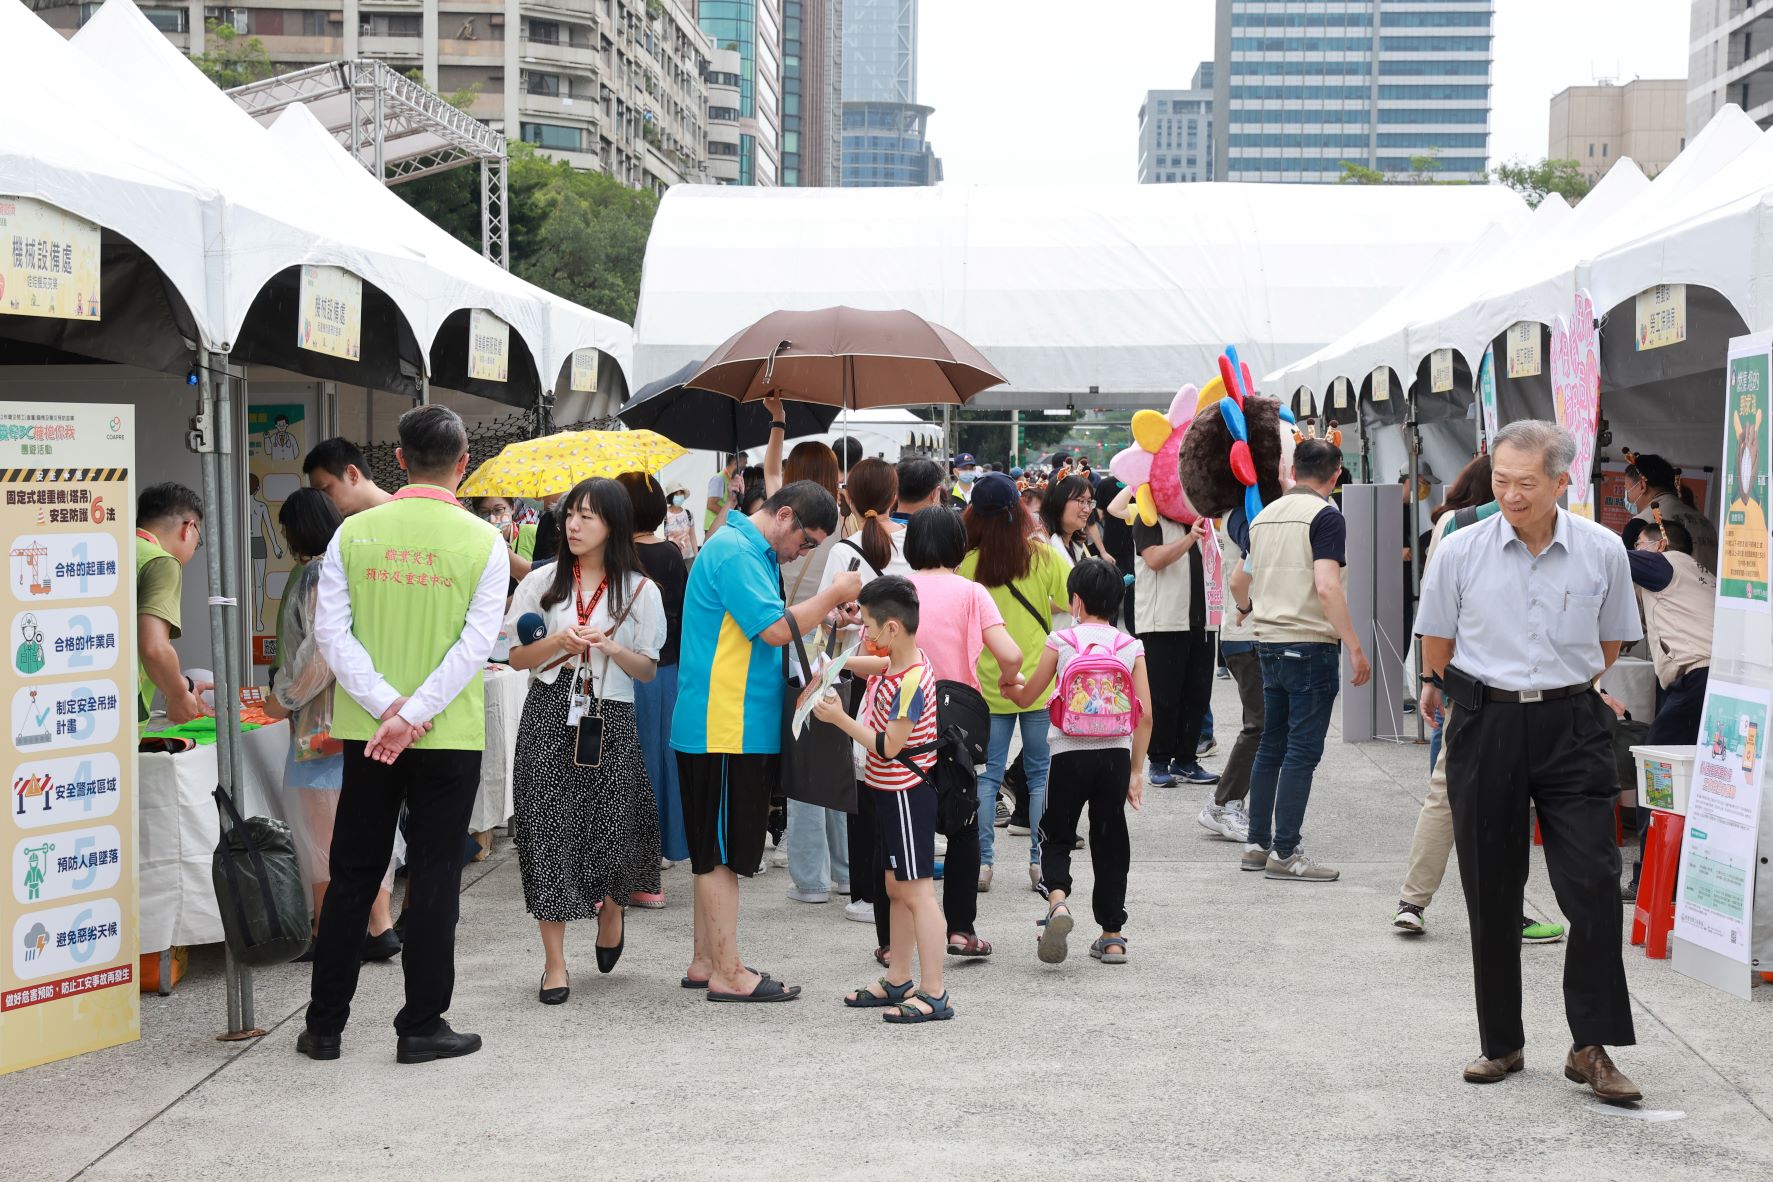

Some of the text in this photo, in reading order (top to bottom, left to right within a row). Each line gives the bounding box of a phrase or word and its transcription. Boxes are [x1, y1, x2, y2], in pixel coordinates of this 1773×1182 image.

[12, 235, 72, 275] 機械設備處
[6, 489, 92, 506] 固定式起重機(塔吊)
[385, 548, 439, 566] 職業災害
[55, 560, 116, 578] 合格的起重機
[366, 568, 453, 587] 預防及重建中心
[54, 633, 116, 653] 合格的作業員
[56, 695, 117, 715] 制定安全吊掛
[56, 718, 77, 735] 計畫
[55, 777, 117, 800] 安全警戒區域
[57, 849, 119, 873] 預防人員墜落
[56, 922, 118, 948] 避免惡劣天候
